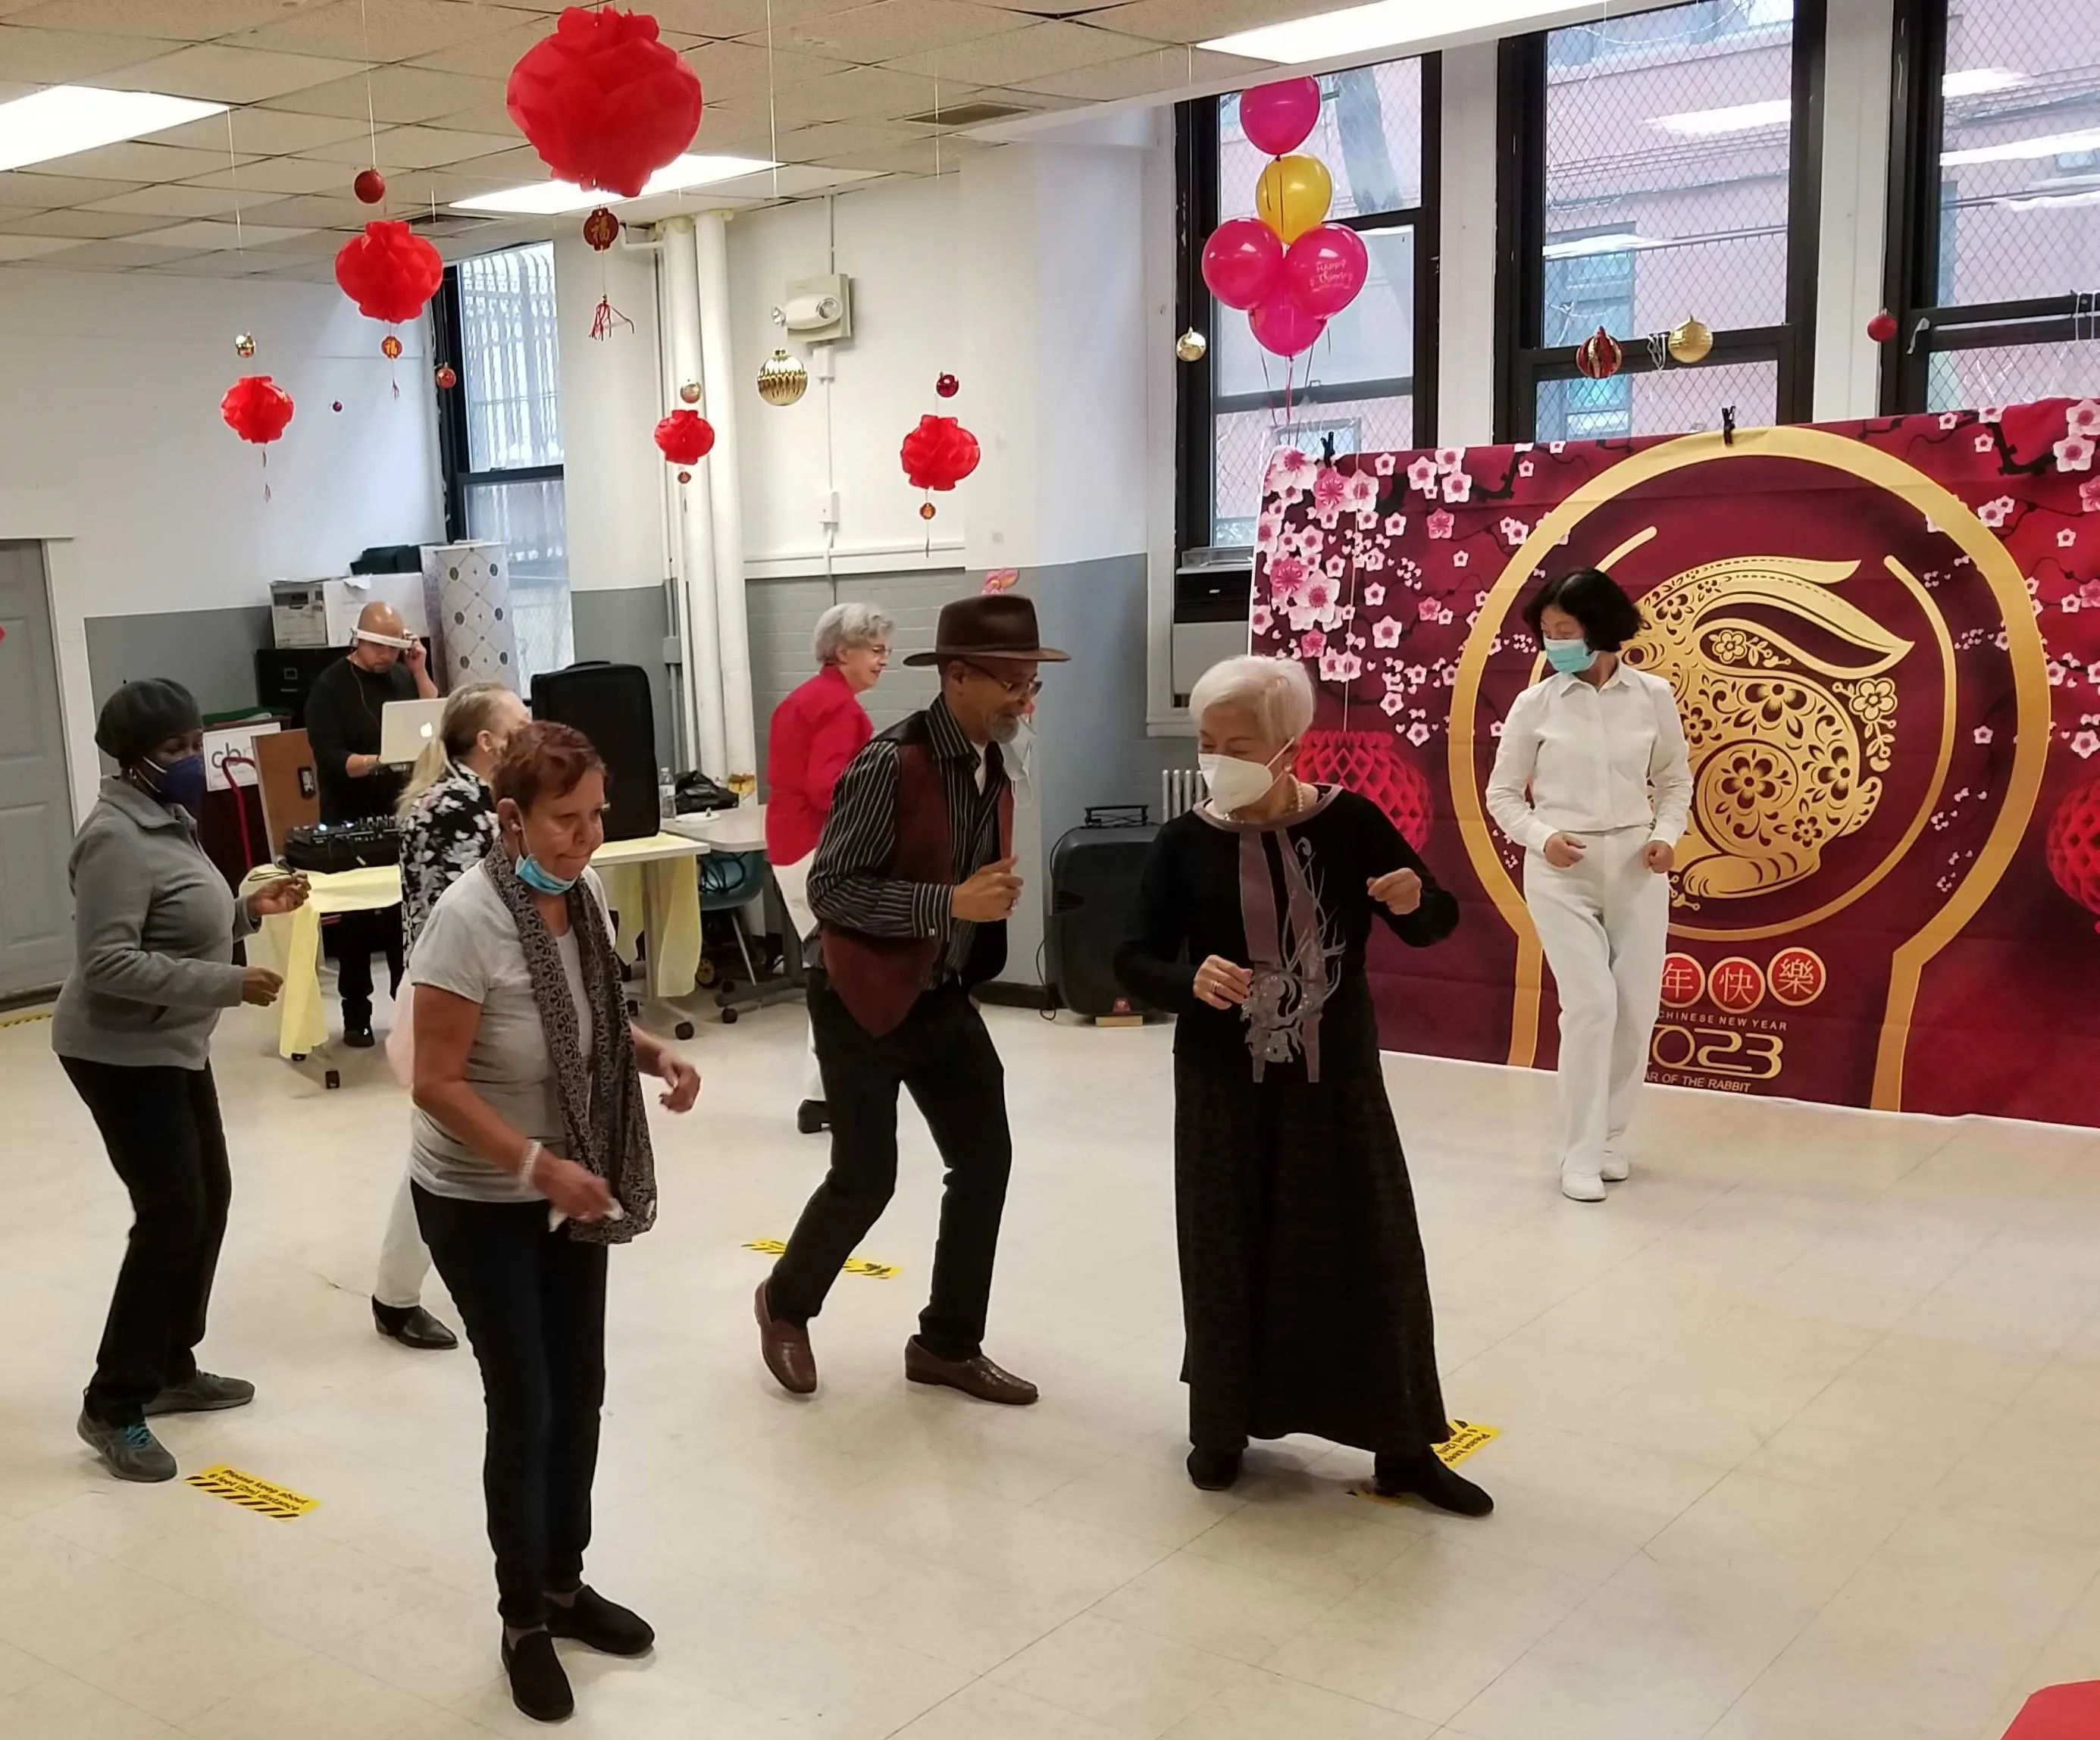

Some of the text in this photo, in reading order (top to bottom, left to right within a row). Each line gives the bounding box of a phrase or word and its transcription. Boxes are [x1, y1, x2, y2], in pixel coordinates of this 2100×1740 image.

[1719, 1017, 1747, 1027] NEW
[1752, 1020, 1788, 1031] YEAR
[1647, 1023, 1784, 1079] 023
[1661, 1073, 1679, 1084] OF
[1682, 1075, 1706, 1088] THE
[1707, 1078, 1752, 1093] RABBIT
